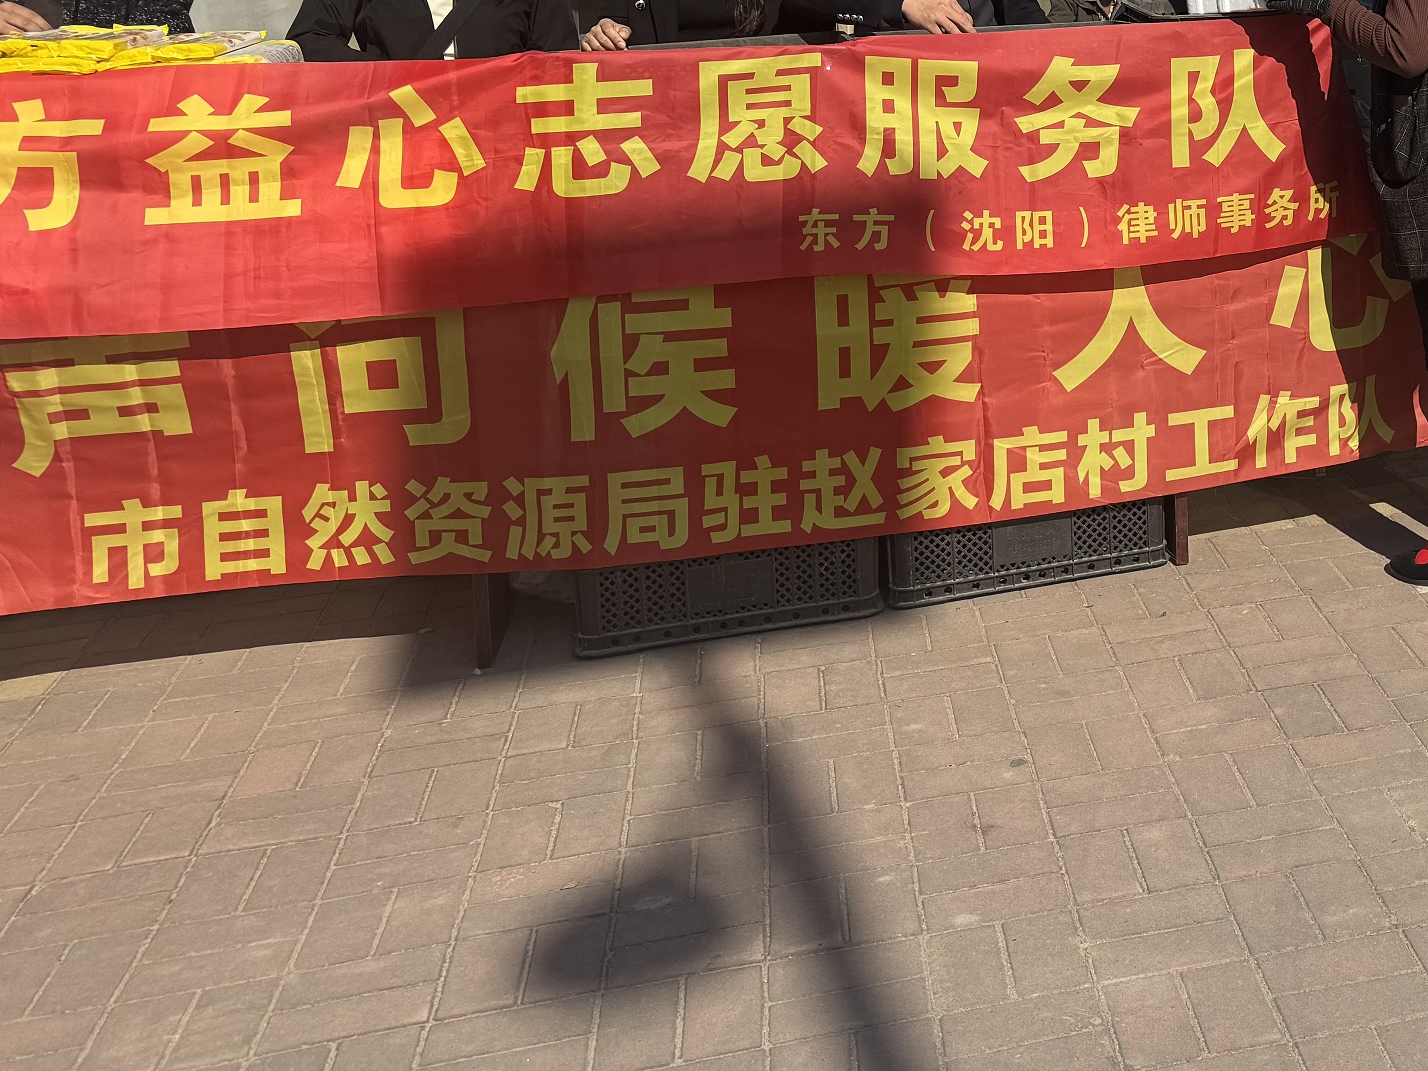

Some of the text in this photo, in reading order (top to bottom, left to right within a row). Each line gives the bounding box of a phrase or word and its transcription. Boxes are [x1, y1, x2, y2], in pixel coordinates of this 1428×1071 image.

[0, 48, 1287, 232] 方益心志愿服务队
[83, 373, 1396, 590] 市自然资源局驻赵家店村工作队
